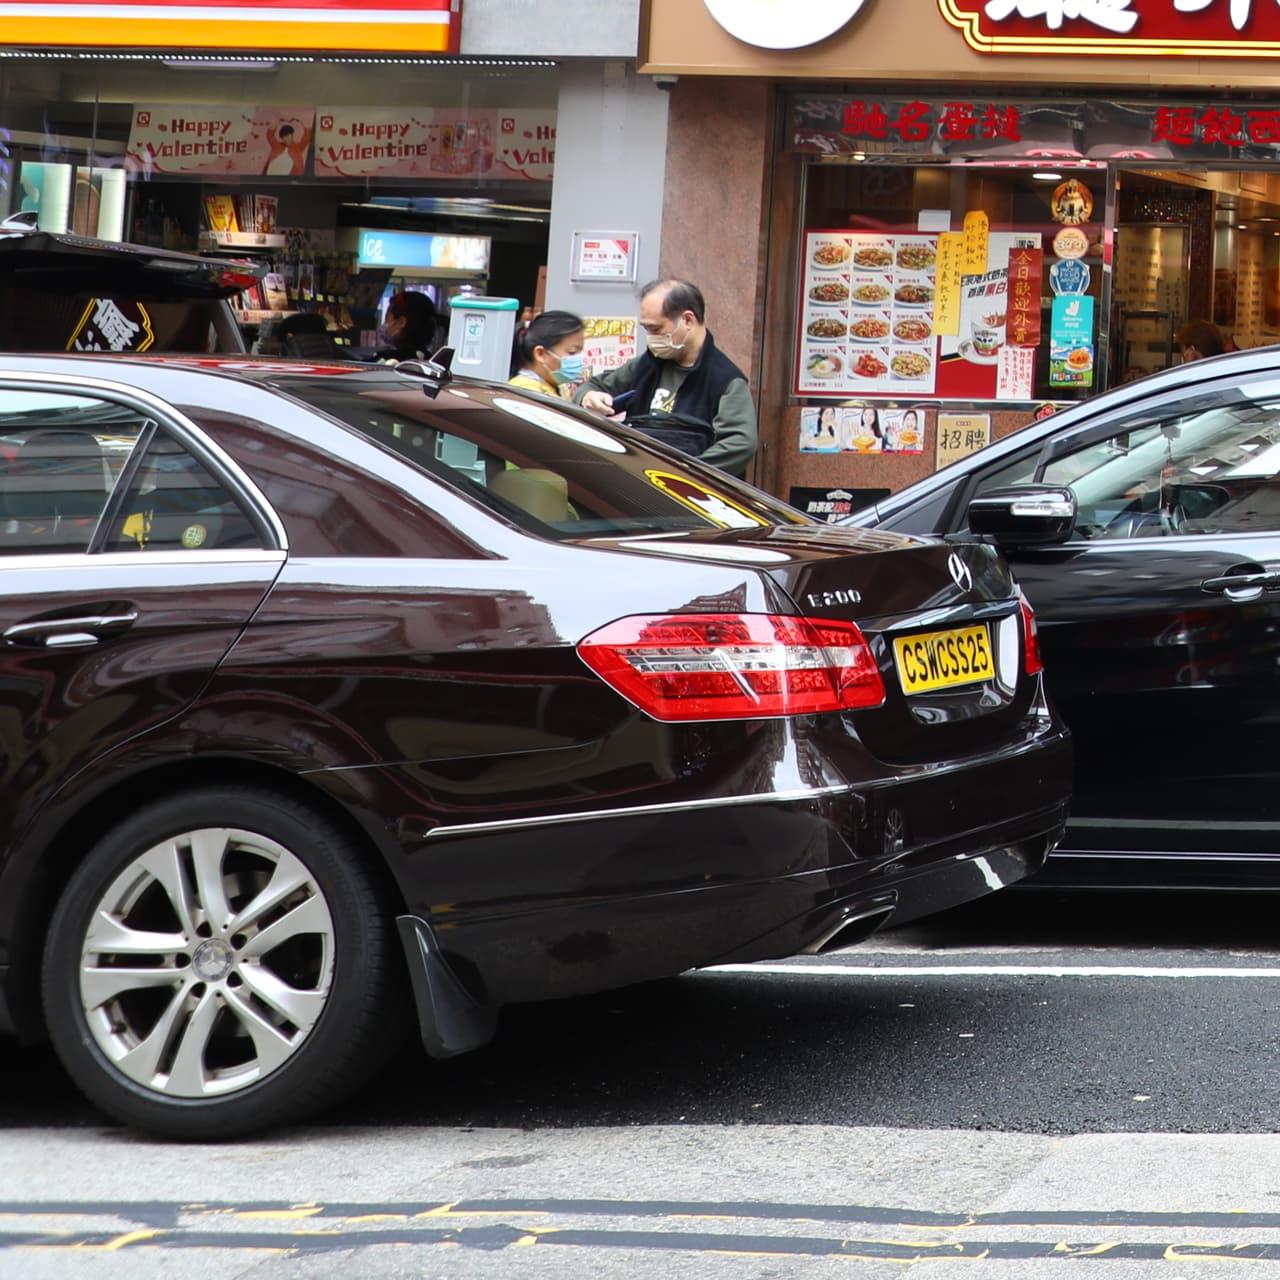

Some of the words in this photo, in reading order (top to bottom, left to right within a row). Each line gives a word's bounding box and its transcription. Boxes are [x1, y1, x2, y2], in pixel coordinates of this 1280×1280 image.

[171, 118, 232, 138] Happy
[351, 121, 410, 141] Happy
[146, 137, 248, 160] Valentine
[328, 140, 428, 163] Valentine
[967, 281, 1008, 299] 首選黑白
[940, 427, 986, 450] 招聘
[807, 588, 861, 609] E200
[901, 633, 989, 686] CSWCSS25
